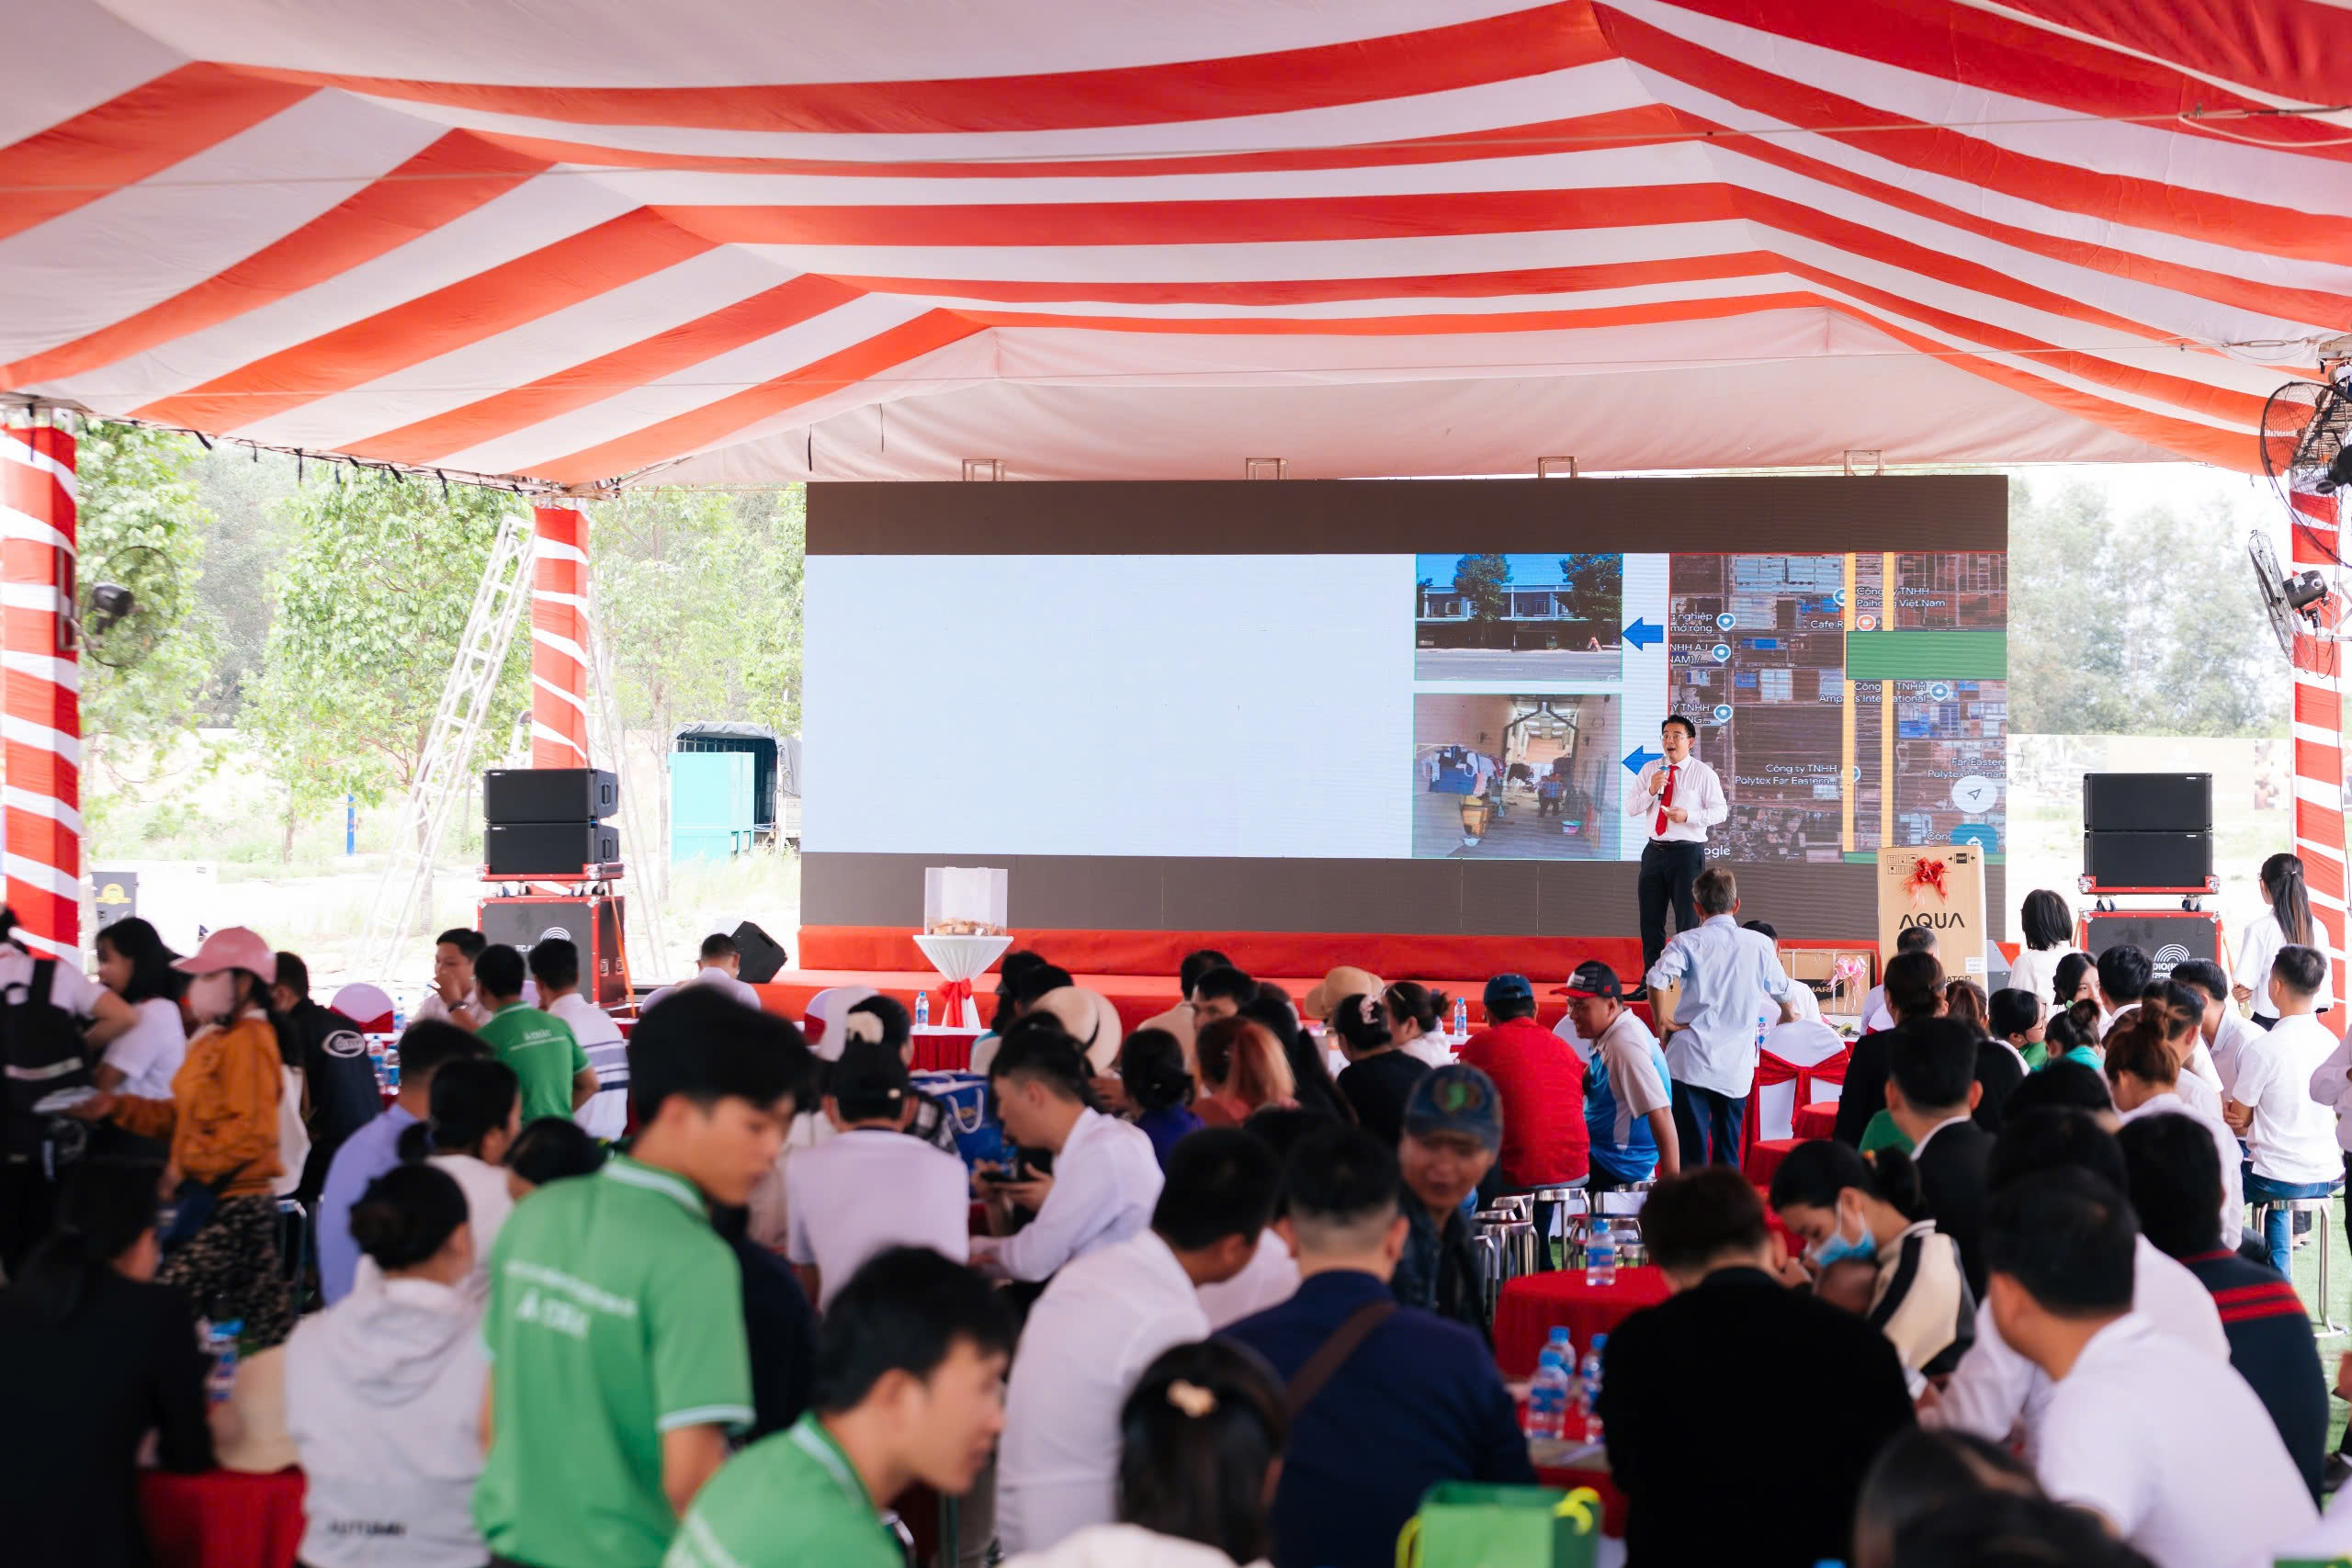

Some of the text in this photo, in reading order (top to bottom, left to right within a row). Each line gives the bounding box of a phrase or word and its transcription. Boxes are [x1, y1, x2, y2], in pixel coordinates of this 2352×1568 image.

[1856, 587, 1883, 597] Công
[1900, 587, 1929, 595] TNHH
[1899, 599, 1919, 609] Việt
[1921, 599, 1946, 607] Nam
[1810, 620, 1836, 628] Cafe
[1689, 625, 1713, 634] rộng
[1694, 643, 1708, 651] AJ
[1854, 682, 1927, 692] Công TNHH
[1680, 703, 1710, 712] TNHH
[1951, 757, 1967, 766] Far
[1765, 763, 1838, 773] Công ty TNHH
[1928, 770, 1964, 779] Polytex
[1735, 776, 1771, 785] Polytex
[1773, 776, 1789, 784] Far
[1898, 912, 1965, 930] AQUA
